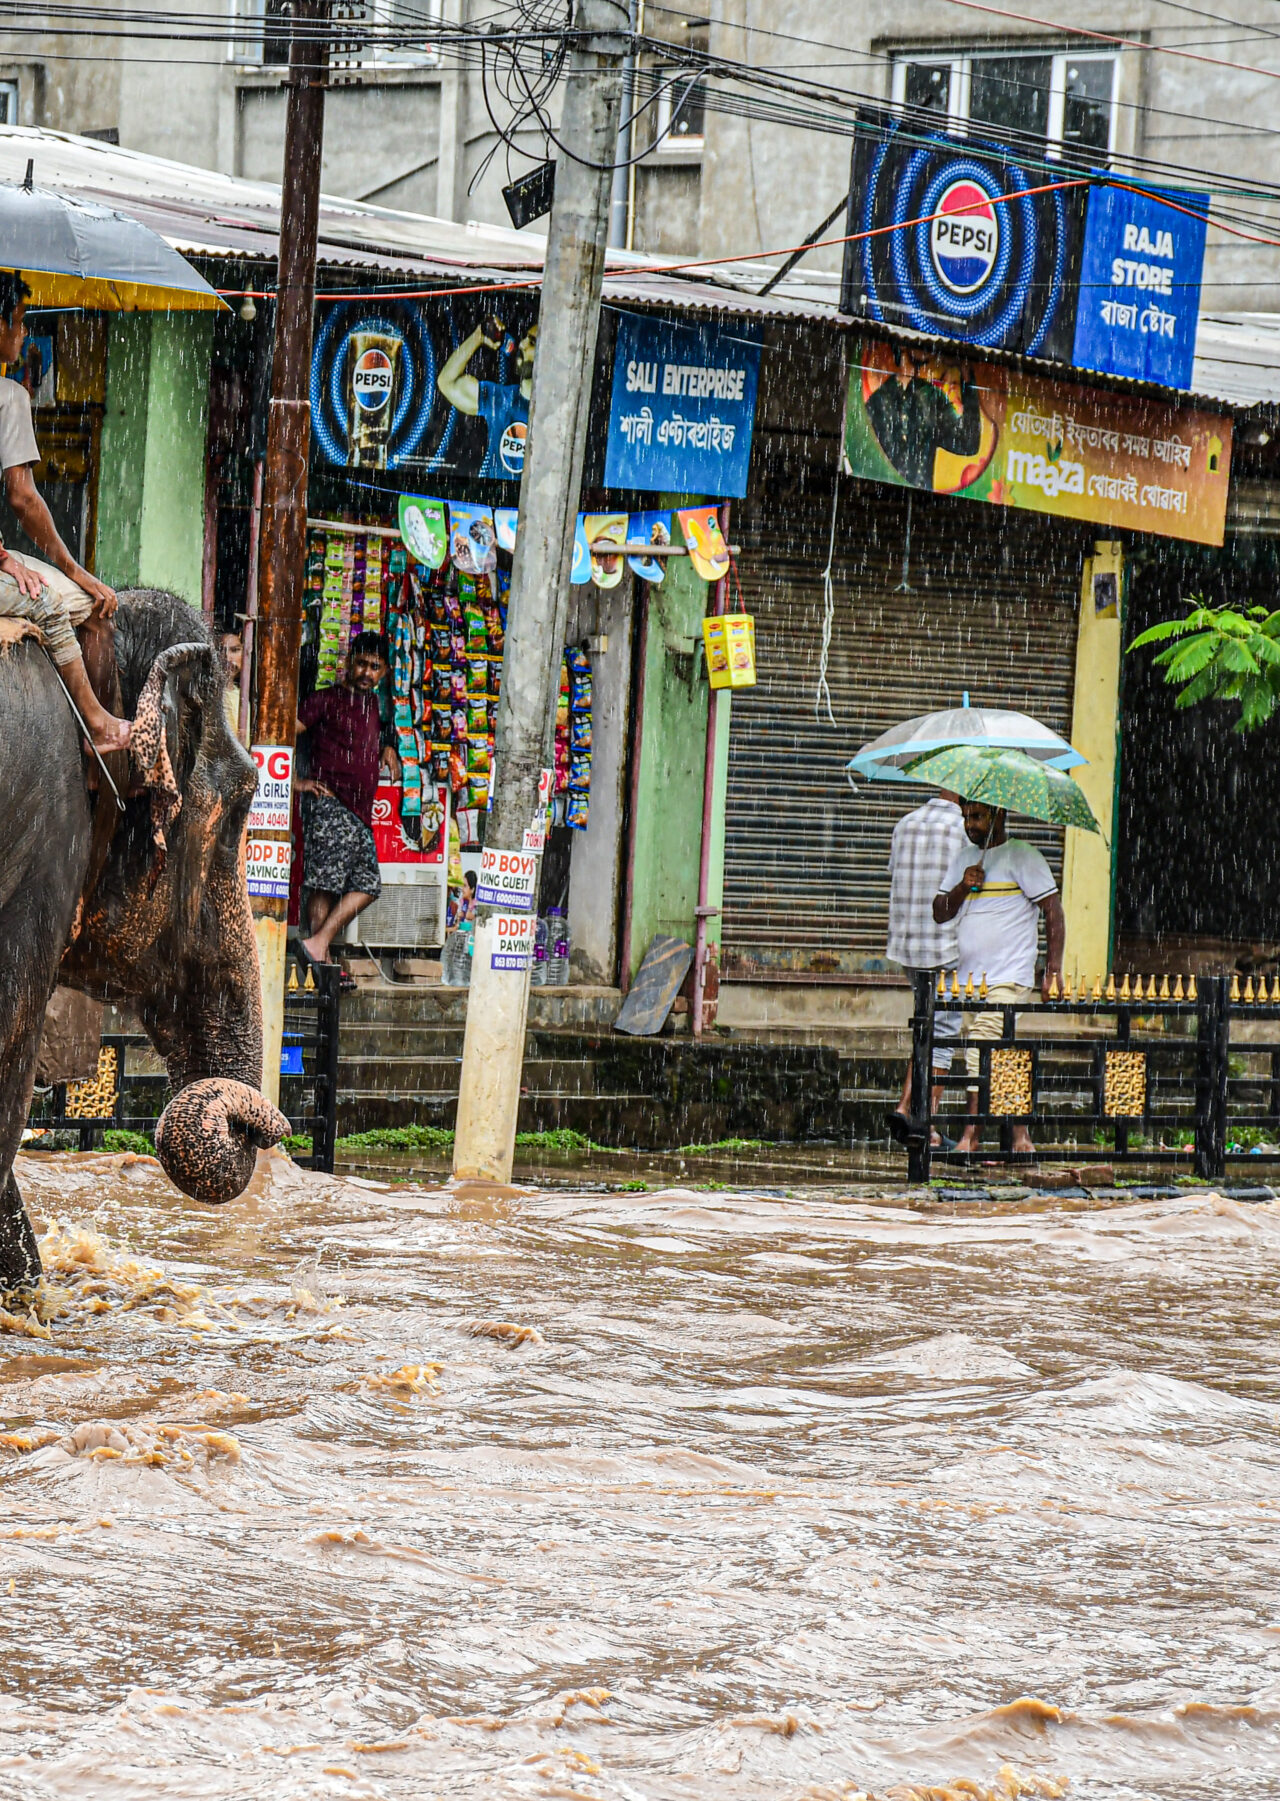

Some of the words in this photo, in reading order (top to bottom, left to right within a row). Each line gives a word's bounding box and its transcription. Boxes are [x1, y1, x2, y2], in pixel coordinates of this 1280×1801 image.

[936, 220, 993, 253] PEPSI
[1123, 223, 1174, 259] RAJA
[1111, 258, 1174, 295] STORE
[355, 372, 391, 388] PEPSI
[626, 360, 658, 394] SALI
[662, 364, 746, 400] ENTERPRISE
[1006, 449, 1085, 497] maaza
[251, 751, 290, 780] PG
[263, 783, 289, 798] GIRLS
[246, 865, 279, 879] PAYING
[482, 851, 496, 870] DP
[499, 854, 534, 876] BOYS
[502, 875, 529, 890] GUEST
[498, 918, 528, 936] DDP
